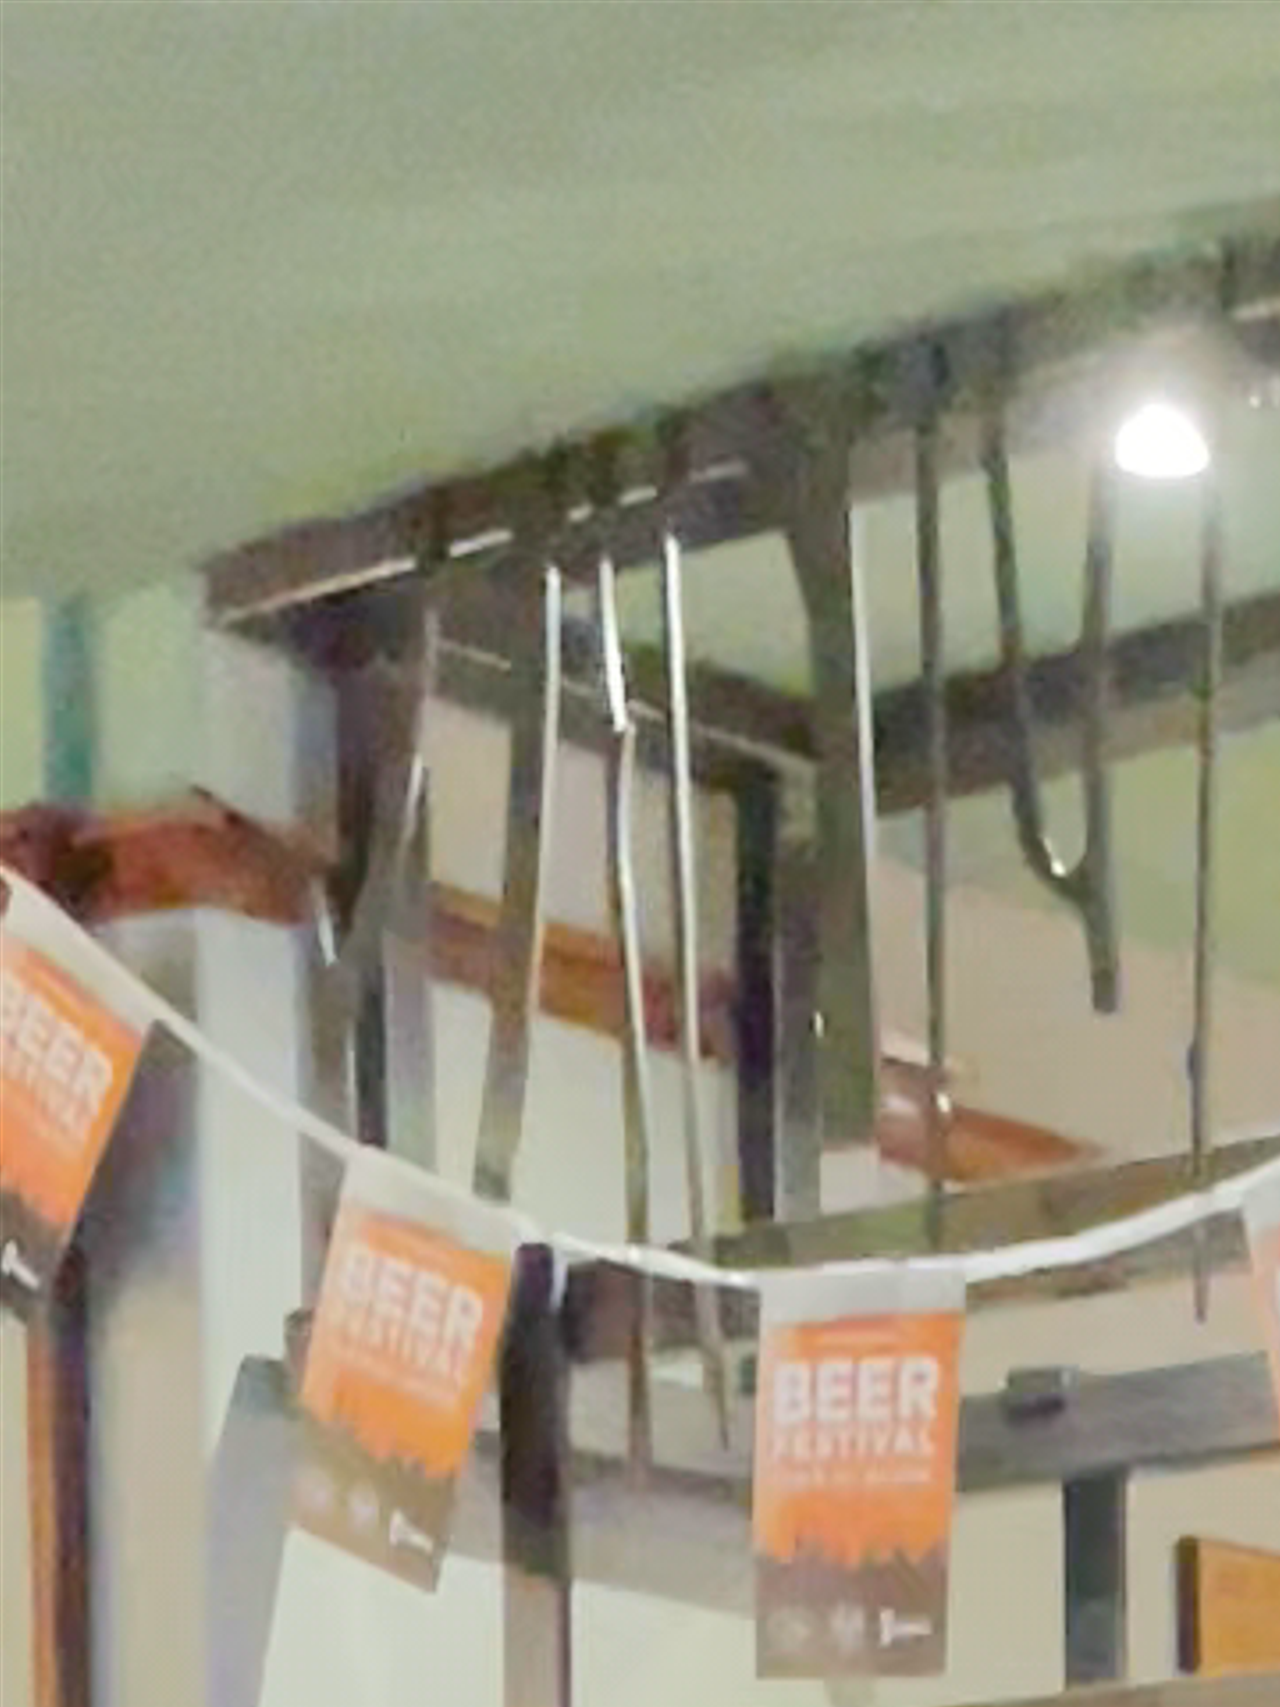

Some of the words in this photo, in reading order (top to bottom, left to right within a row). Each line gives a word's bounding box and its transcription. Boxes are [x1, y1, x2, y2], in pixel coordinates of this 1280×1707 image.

[338, 1244, 483, 1350] BEER
[772, 1357, 938, 1422] BEER
[770, 1422, 935, 1458] FESTIVAL
